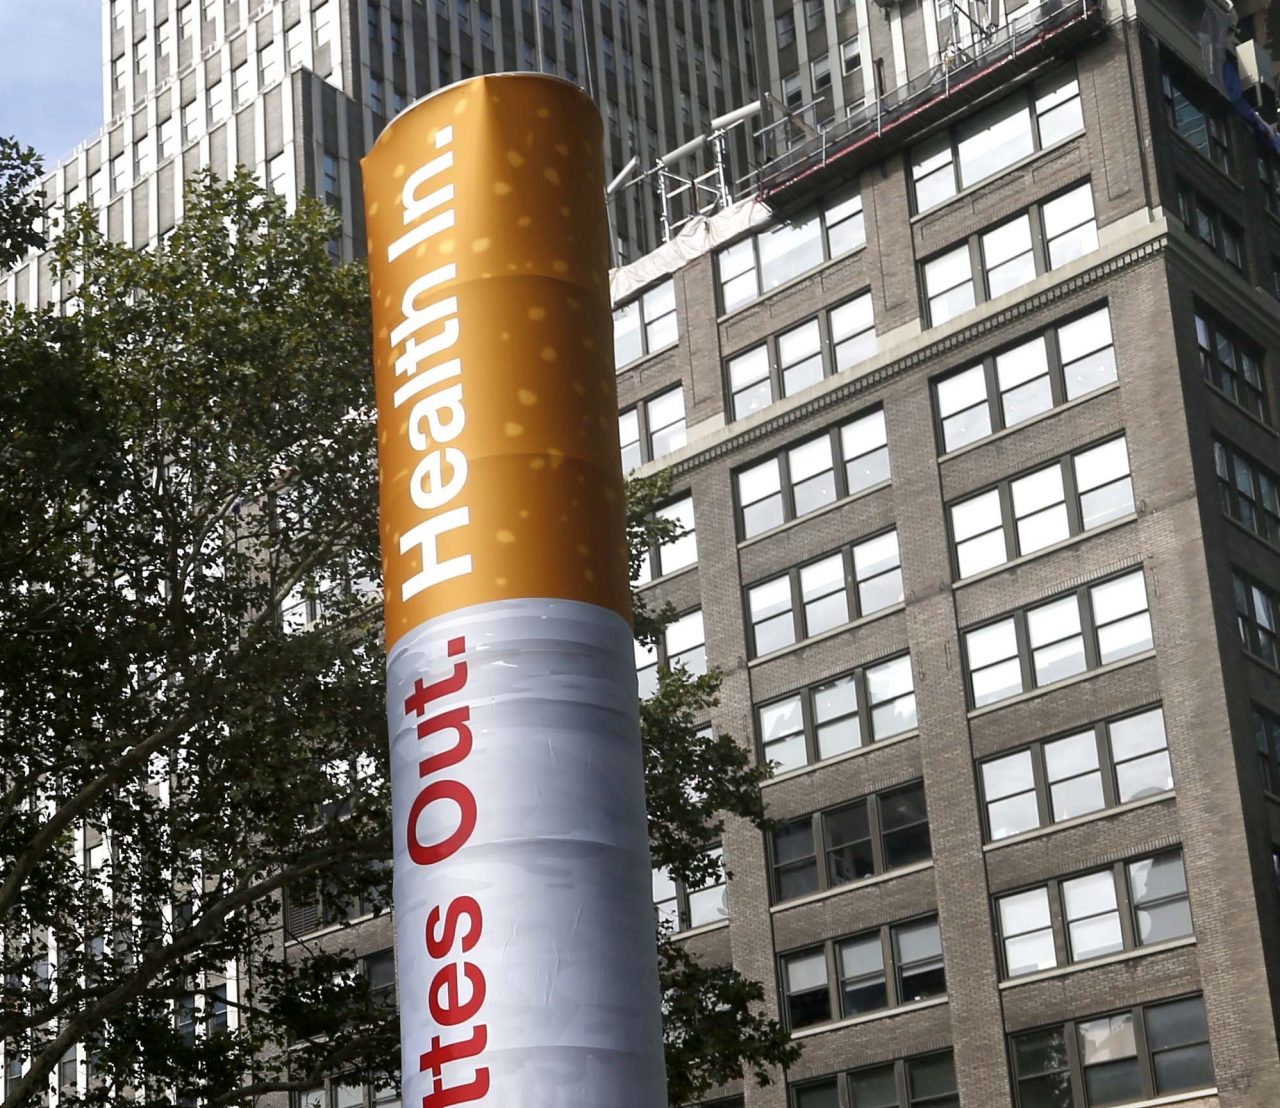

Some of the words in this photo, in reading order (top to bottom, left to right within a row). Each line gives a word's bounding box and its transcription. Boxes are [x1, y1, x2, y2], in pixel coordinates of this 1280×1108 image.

[388, 124, 455, 263] In.
[390, 263, 472, 603] Health
[405, 635, 477, 867] Out.
